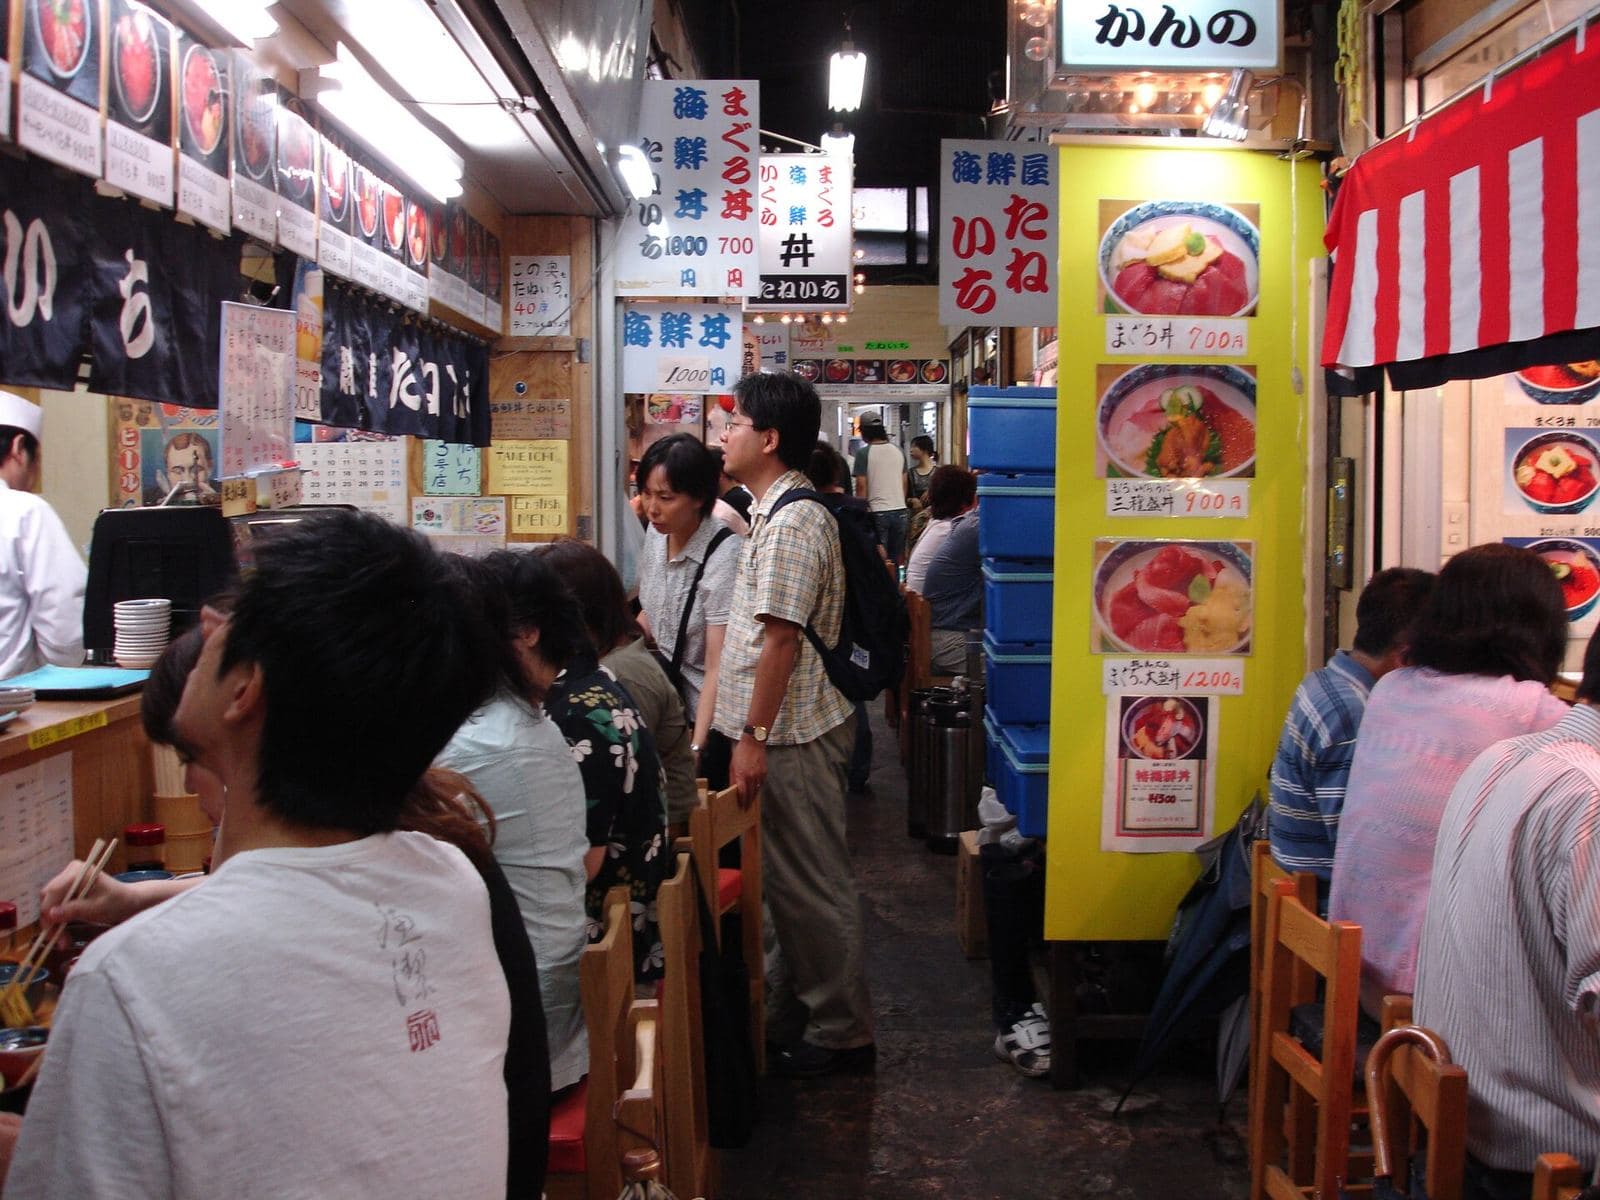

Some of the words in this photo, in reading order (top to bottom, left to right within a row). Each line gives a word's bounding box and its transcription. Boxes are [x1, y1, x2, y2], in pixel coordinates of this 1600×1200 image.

[1095, 4, 1256, 48] かんの
[673, 86, 708, 220] 海鮮丼
[721, 86, 754, 221] まぐろ丼
[952, 151, 1049, 186] 海鮮屋
[760, 165, 778, 226] いくら
[789, 165, 807, 226] 海鮮
[817, 165, 834, 228] まぐろ
[624, 311, 731, 349] 海鮮丼
[1112, 322, 1174, 349] まぐろ丼
[1112, 493, 1174, 514] 三種盛丼
